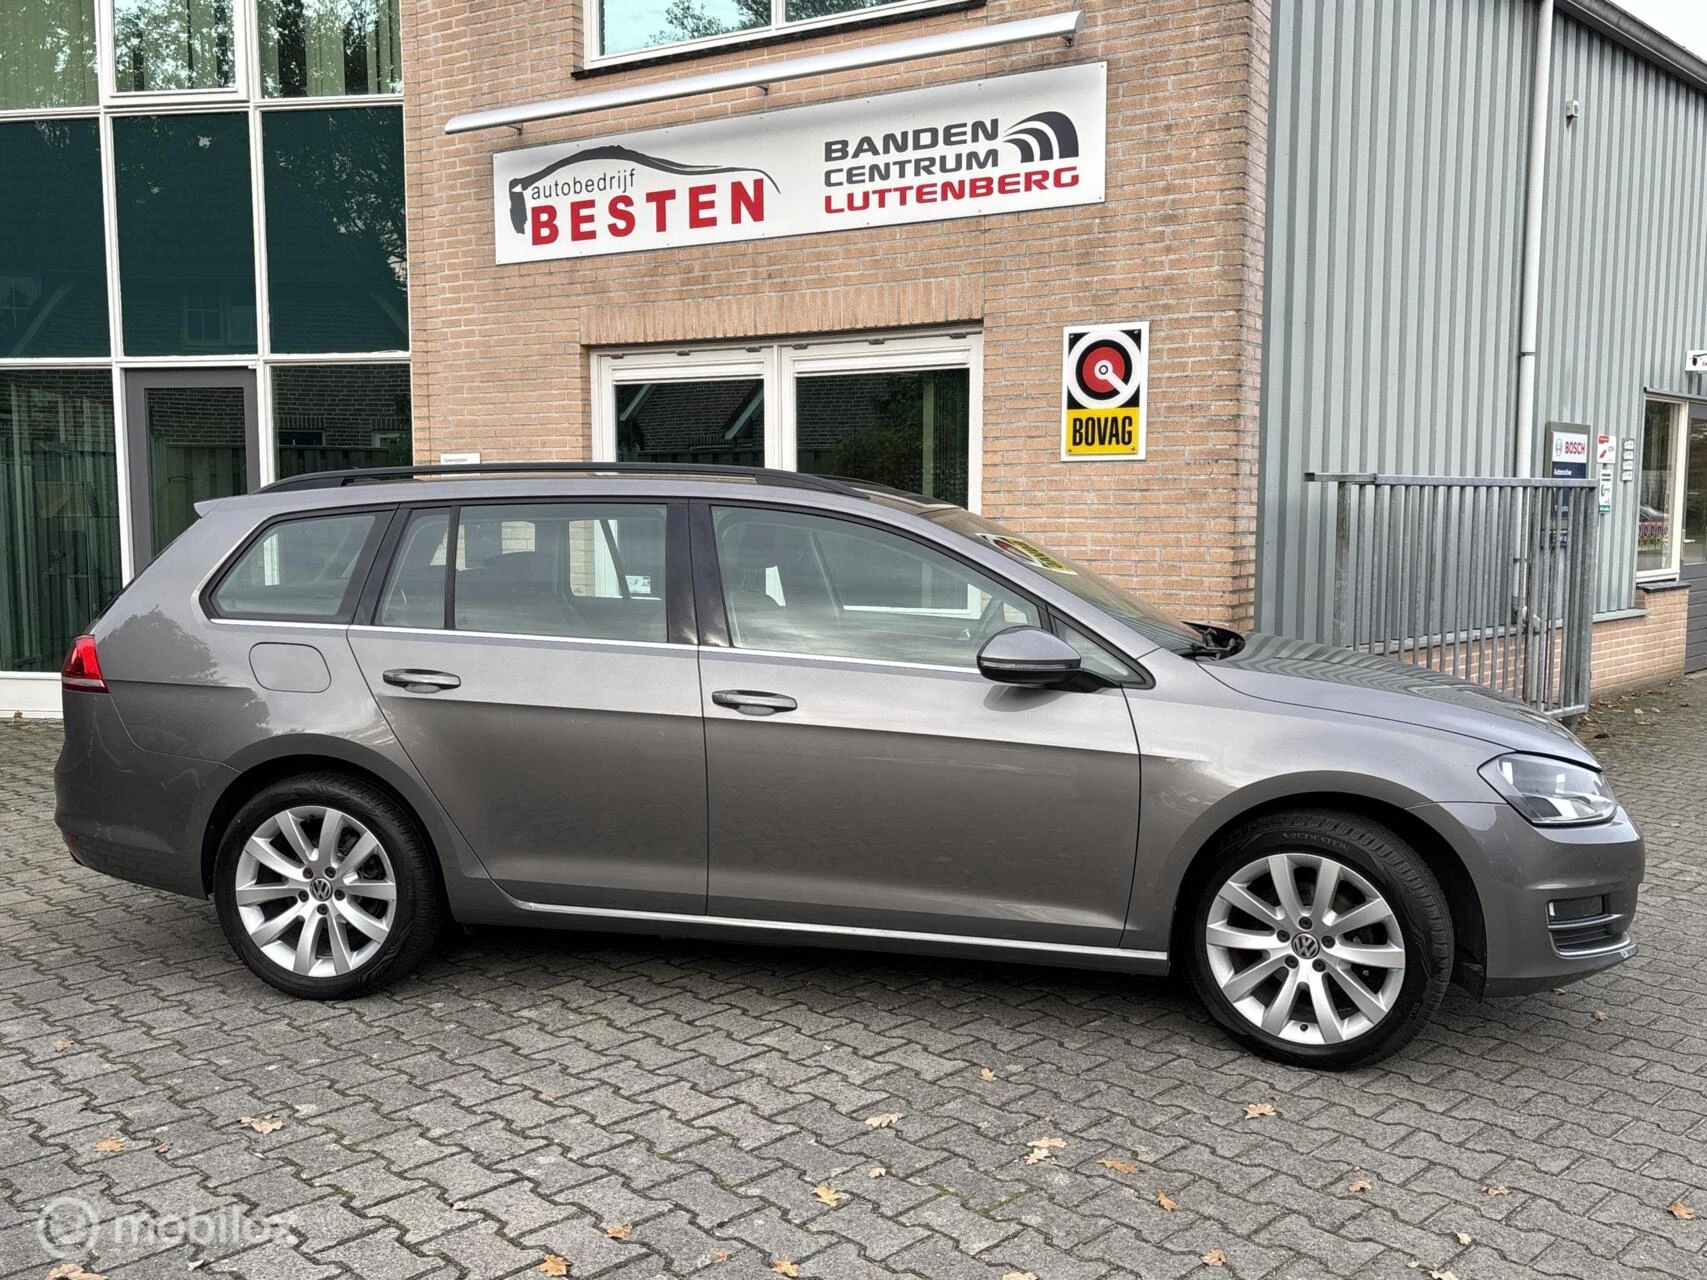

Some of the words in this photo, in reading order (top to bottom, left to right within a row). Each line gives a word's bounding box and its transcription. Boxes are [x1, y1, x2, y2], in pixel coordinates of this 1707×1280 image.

[824, 118, 999, 162] BANDEN
[531, 168, 636, 200] autobedrijf
[824, 148, 999, 187] CENTRUM
[824, 166, 1080, 214] LUTTENBERG
[531, 178, 764, 246] BESTEN
[1072, 416, 1133, 447] BOVAG
[1565, 441, 1585, 455] BOSCH
